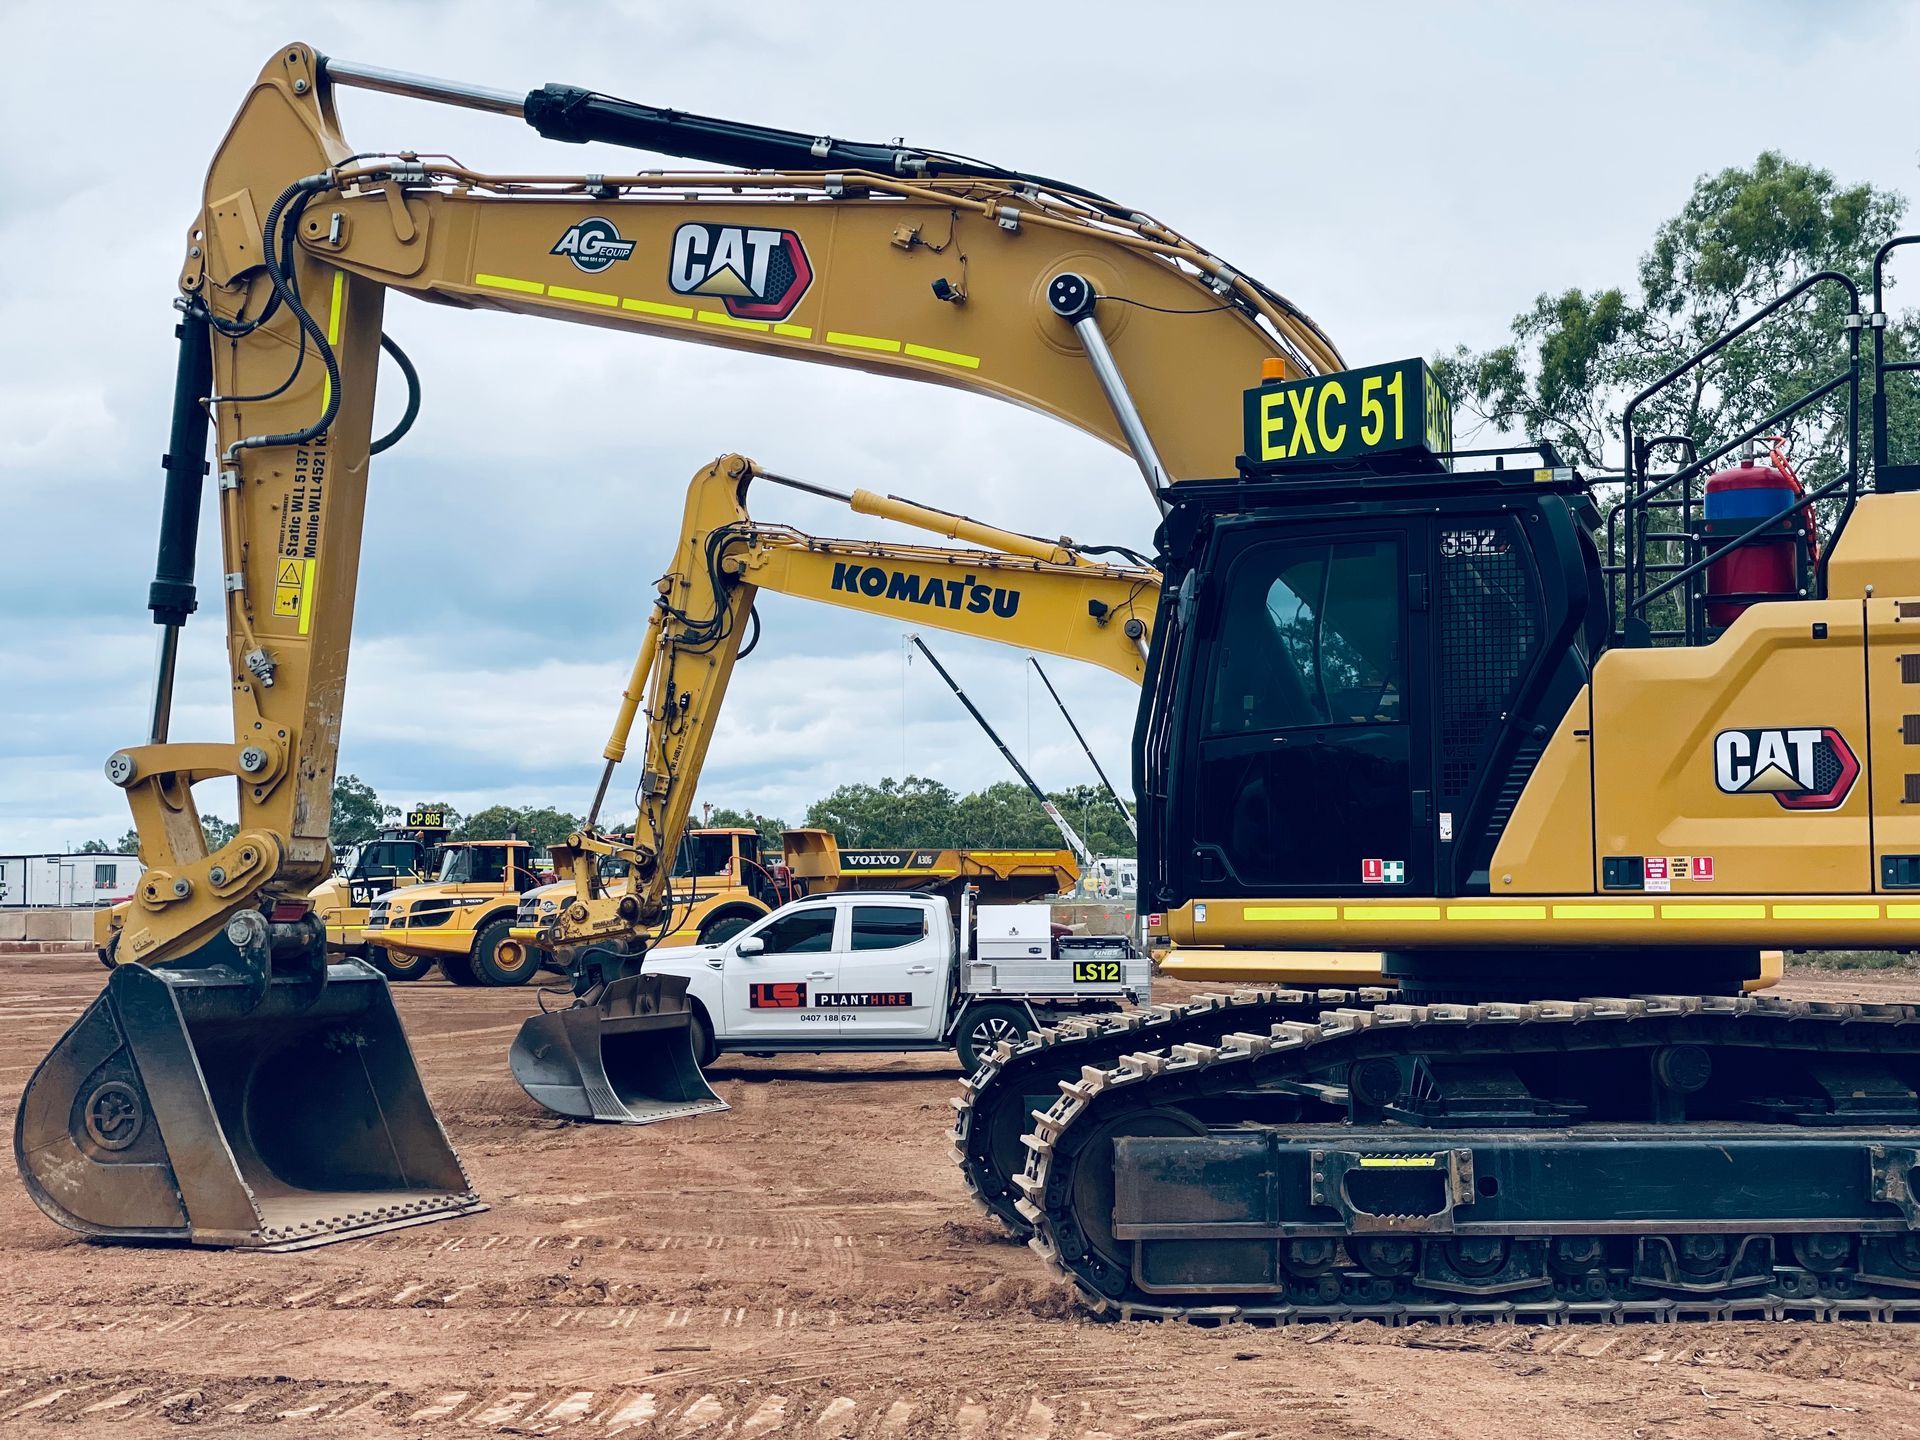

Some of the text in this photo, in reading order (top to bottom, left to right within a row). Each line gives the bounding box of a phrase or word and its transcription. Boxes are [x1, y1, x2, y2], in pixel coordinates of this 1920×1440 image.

[555, 228, 632, 255] AG
[599, 247, 630, 257] EQUIP
[671, 224, 782, 298] CAT
[1260, 371, 1404, 461] EXC 51
[294, 449, 309, 483] 5137
[311, 451, 326, 484] 4521
[291, 485, 305, 512] WLL
[308, 486, 322, 512] WLL
[286, 516, 301, 556] Static
[304, 514, 320, 558] Mobile
[1441, 529, 1496, 556] 352
[831, 562, 1020, 618] KOMATSU
[1715, 729, 1822, 792] CAT
[410, 813, 441, 825] CP 805
[846, 855, 933, 865] VOLVO A30G
[353, 887, 380, 904] CAT
[1075, 963, 1119, 981] LS12
[757, 984, 799, 1008] LS
[800, 1014, 857, 1022] 0407 188 674
